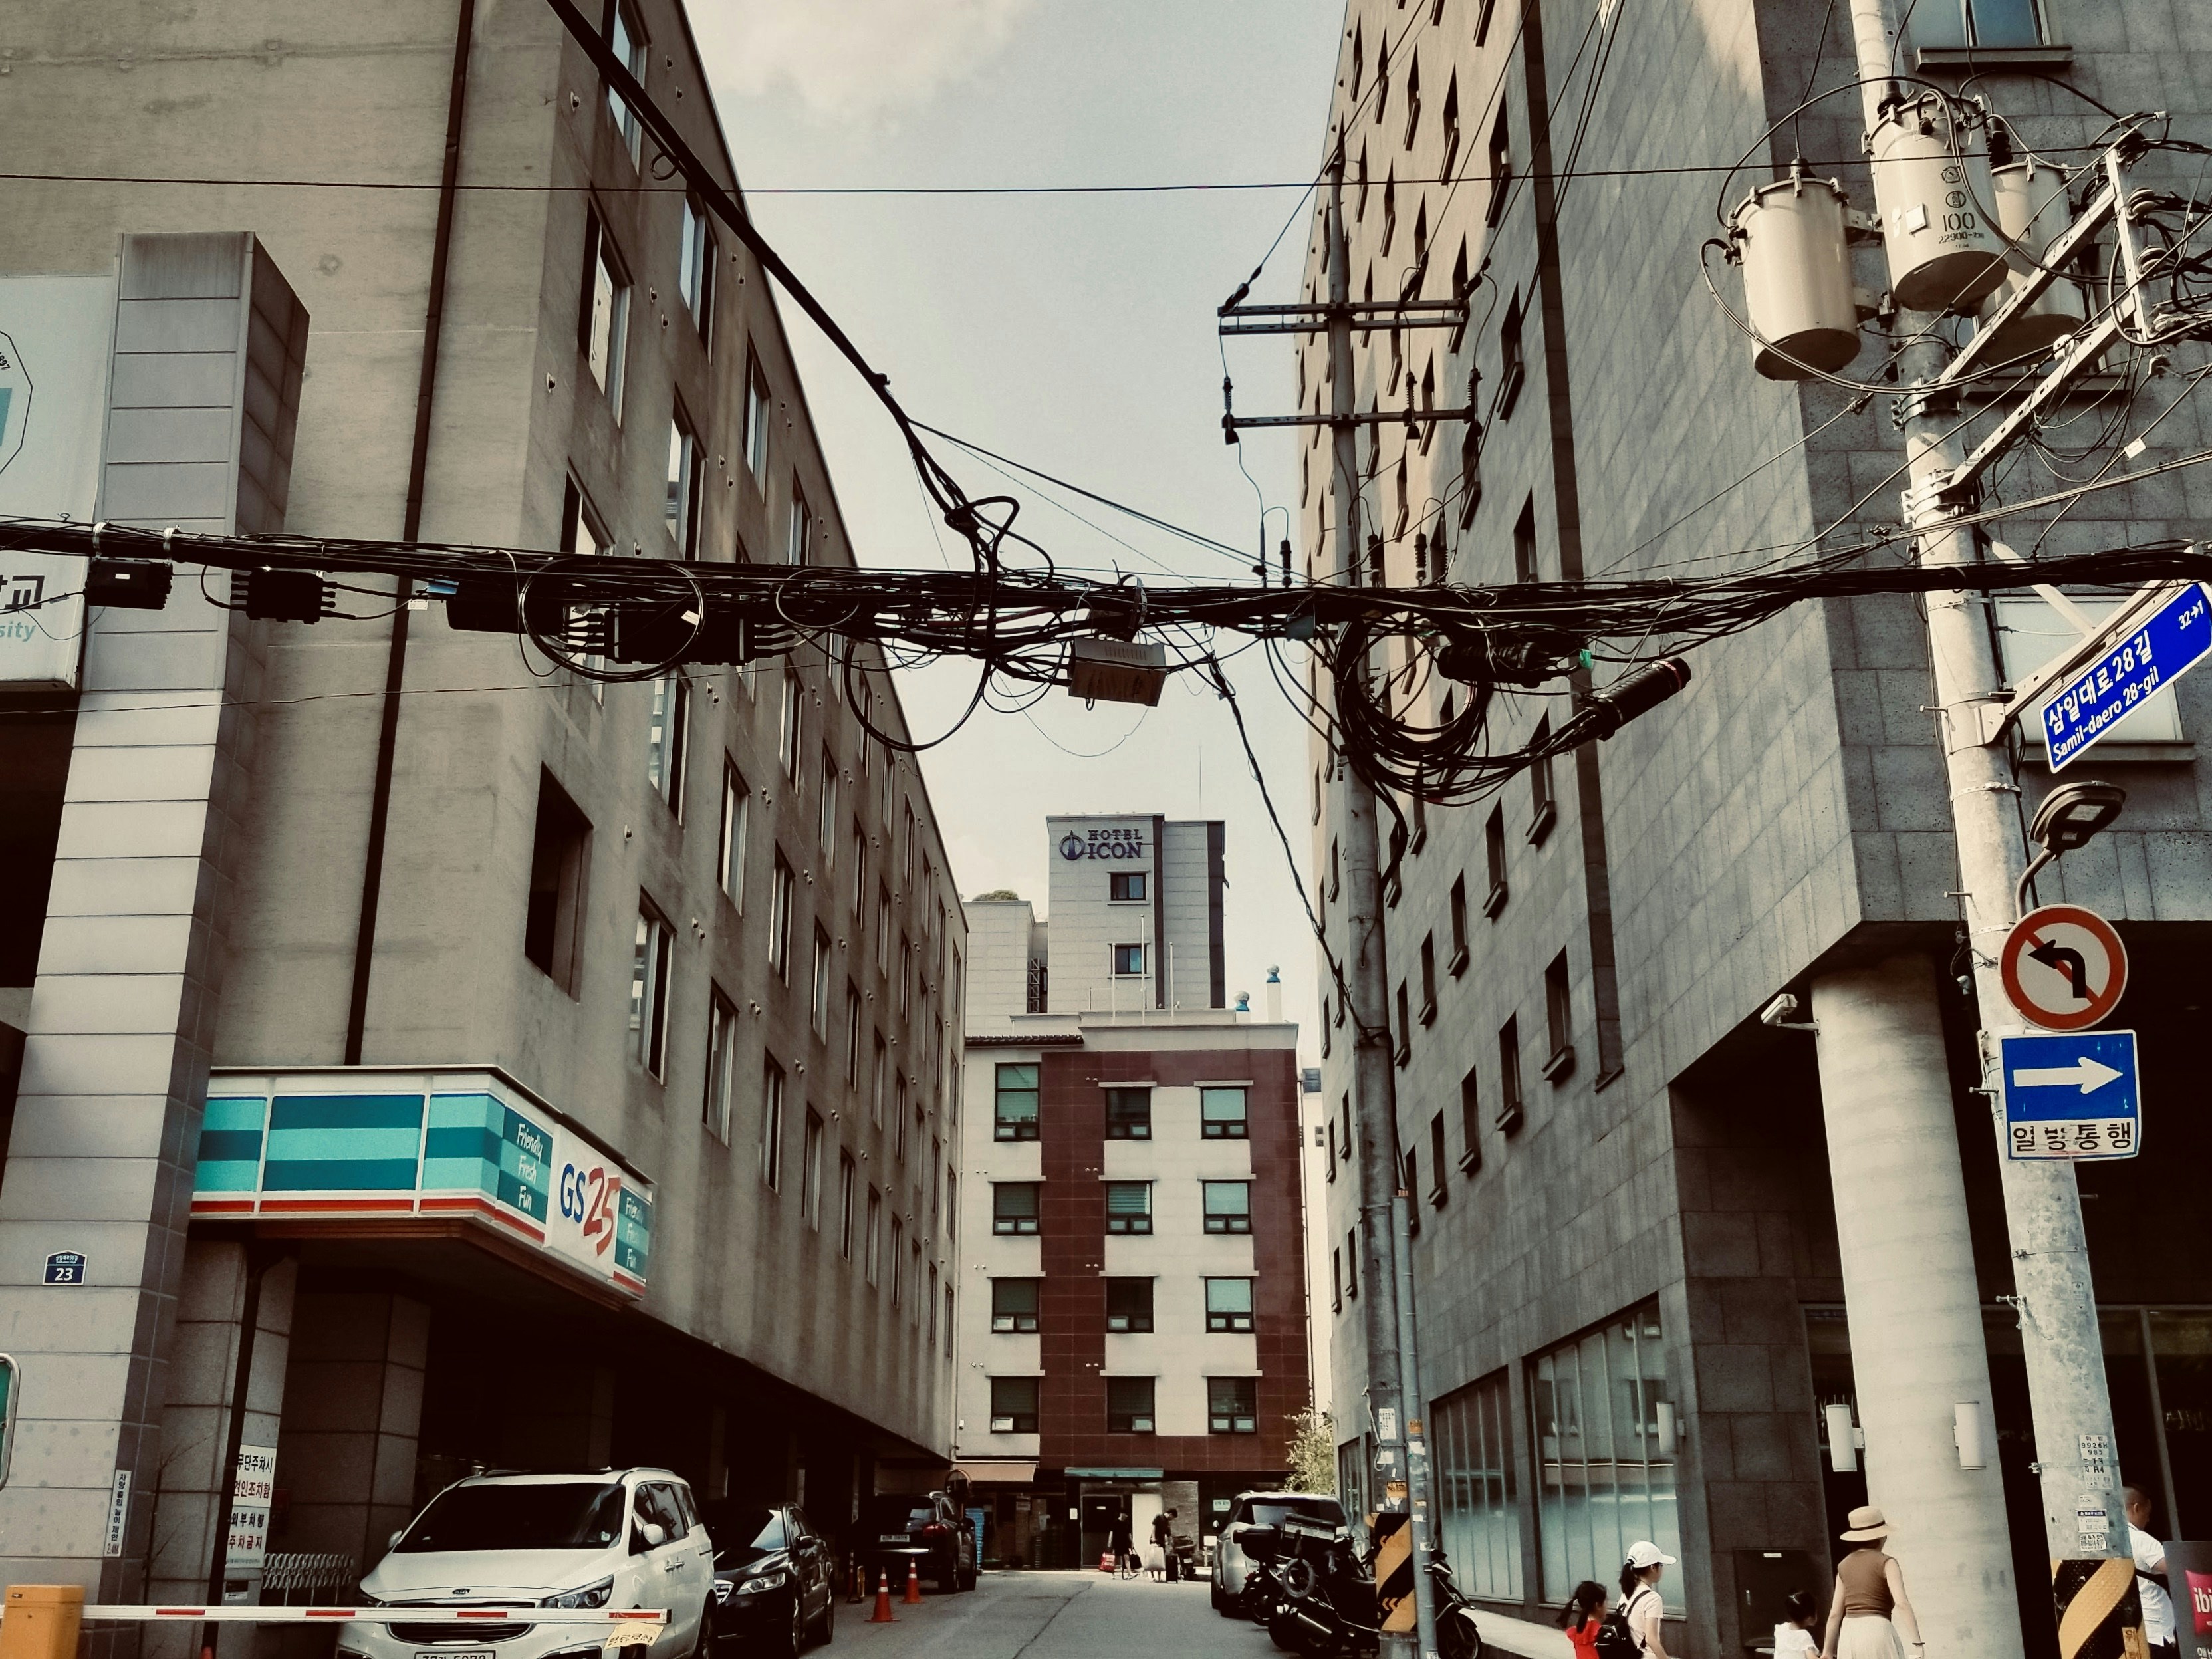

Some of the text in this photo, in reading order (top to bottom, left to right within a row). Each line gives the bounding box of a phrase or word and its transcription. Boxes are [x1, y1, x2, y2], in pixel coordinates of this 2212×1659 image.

[1943, 212, 1975, 232] 100
[2049, 630, 2153, 735] 삼일대로28길
[2053, 665, 2159, 761] Samil-daero 28-gil
[1088, 829, 1143, 840] HOTEL
[1088, 842, 1142, 860] ICON
[2013, 1122, 2131, 1152] 일방통행
[560, 1163, 622, 1257] GS25
[55, 1267, 74, 1281] 23
